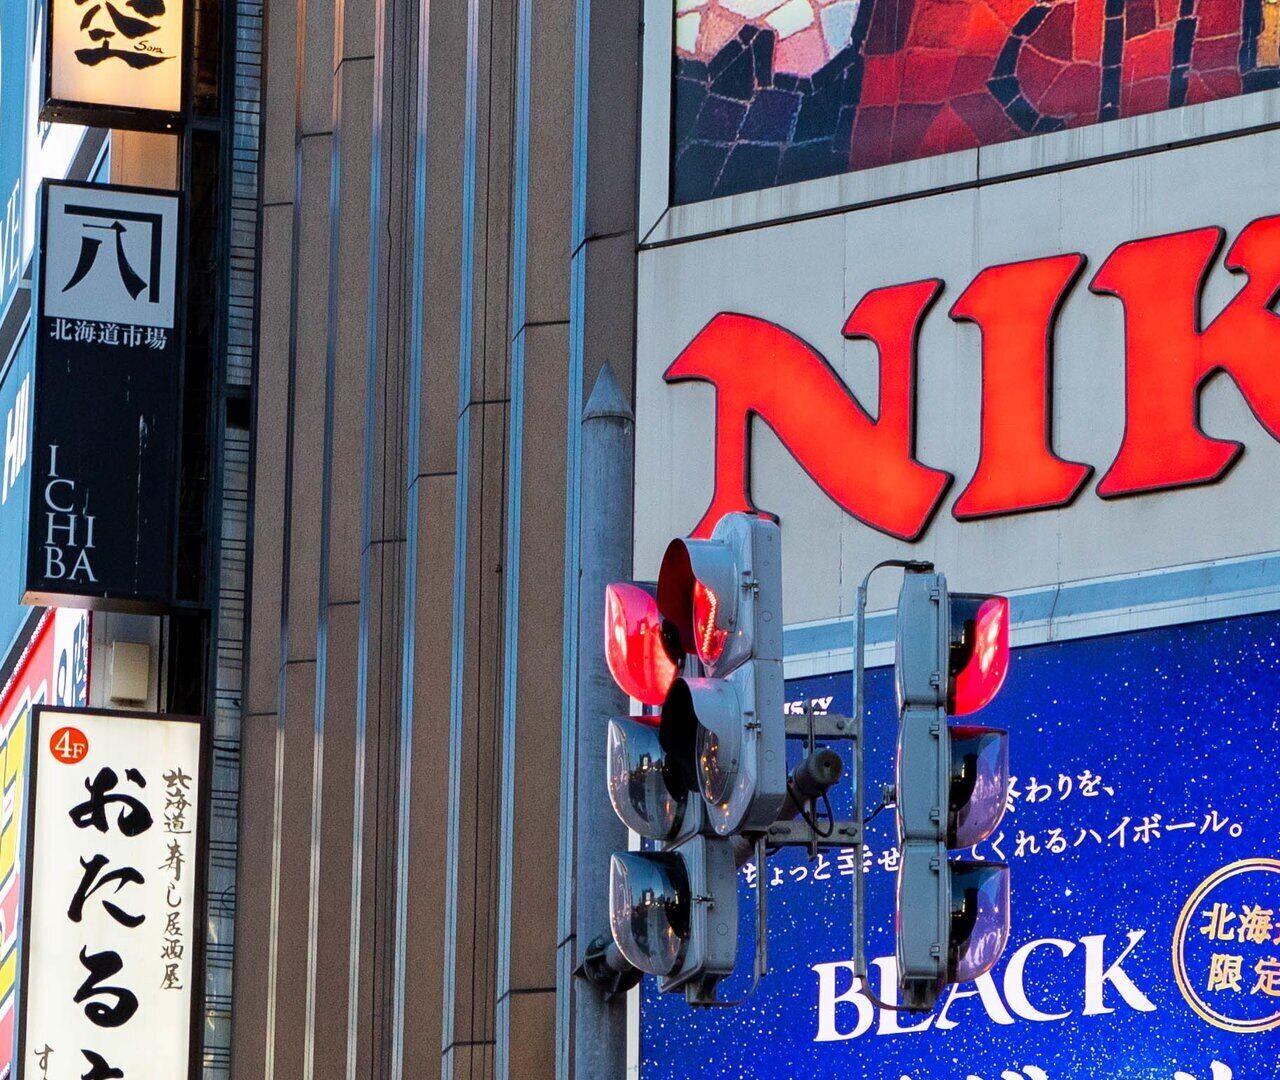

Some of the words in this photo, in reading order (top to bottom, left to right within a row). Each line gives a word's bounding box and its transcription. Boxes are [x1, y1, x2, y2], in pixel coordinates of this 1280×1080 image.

[50, 317, 167, 351] 北海道市場
[53, 731, 86, 759] 4F
[812, 930, 1157, 1042] BLACK
